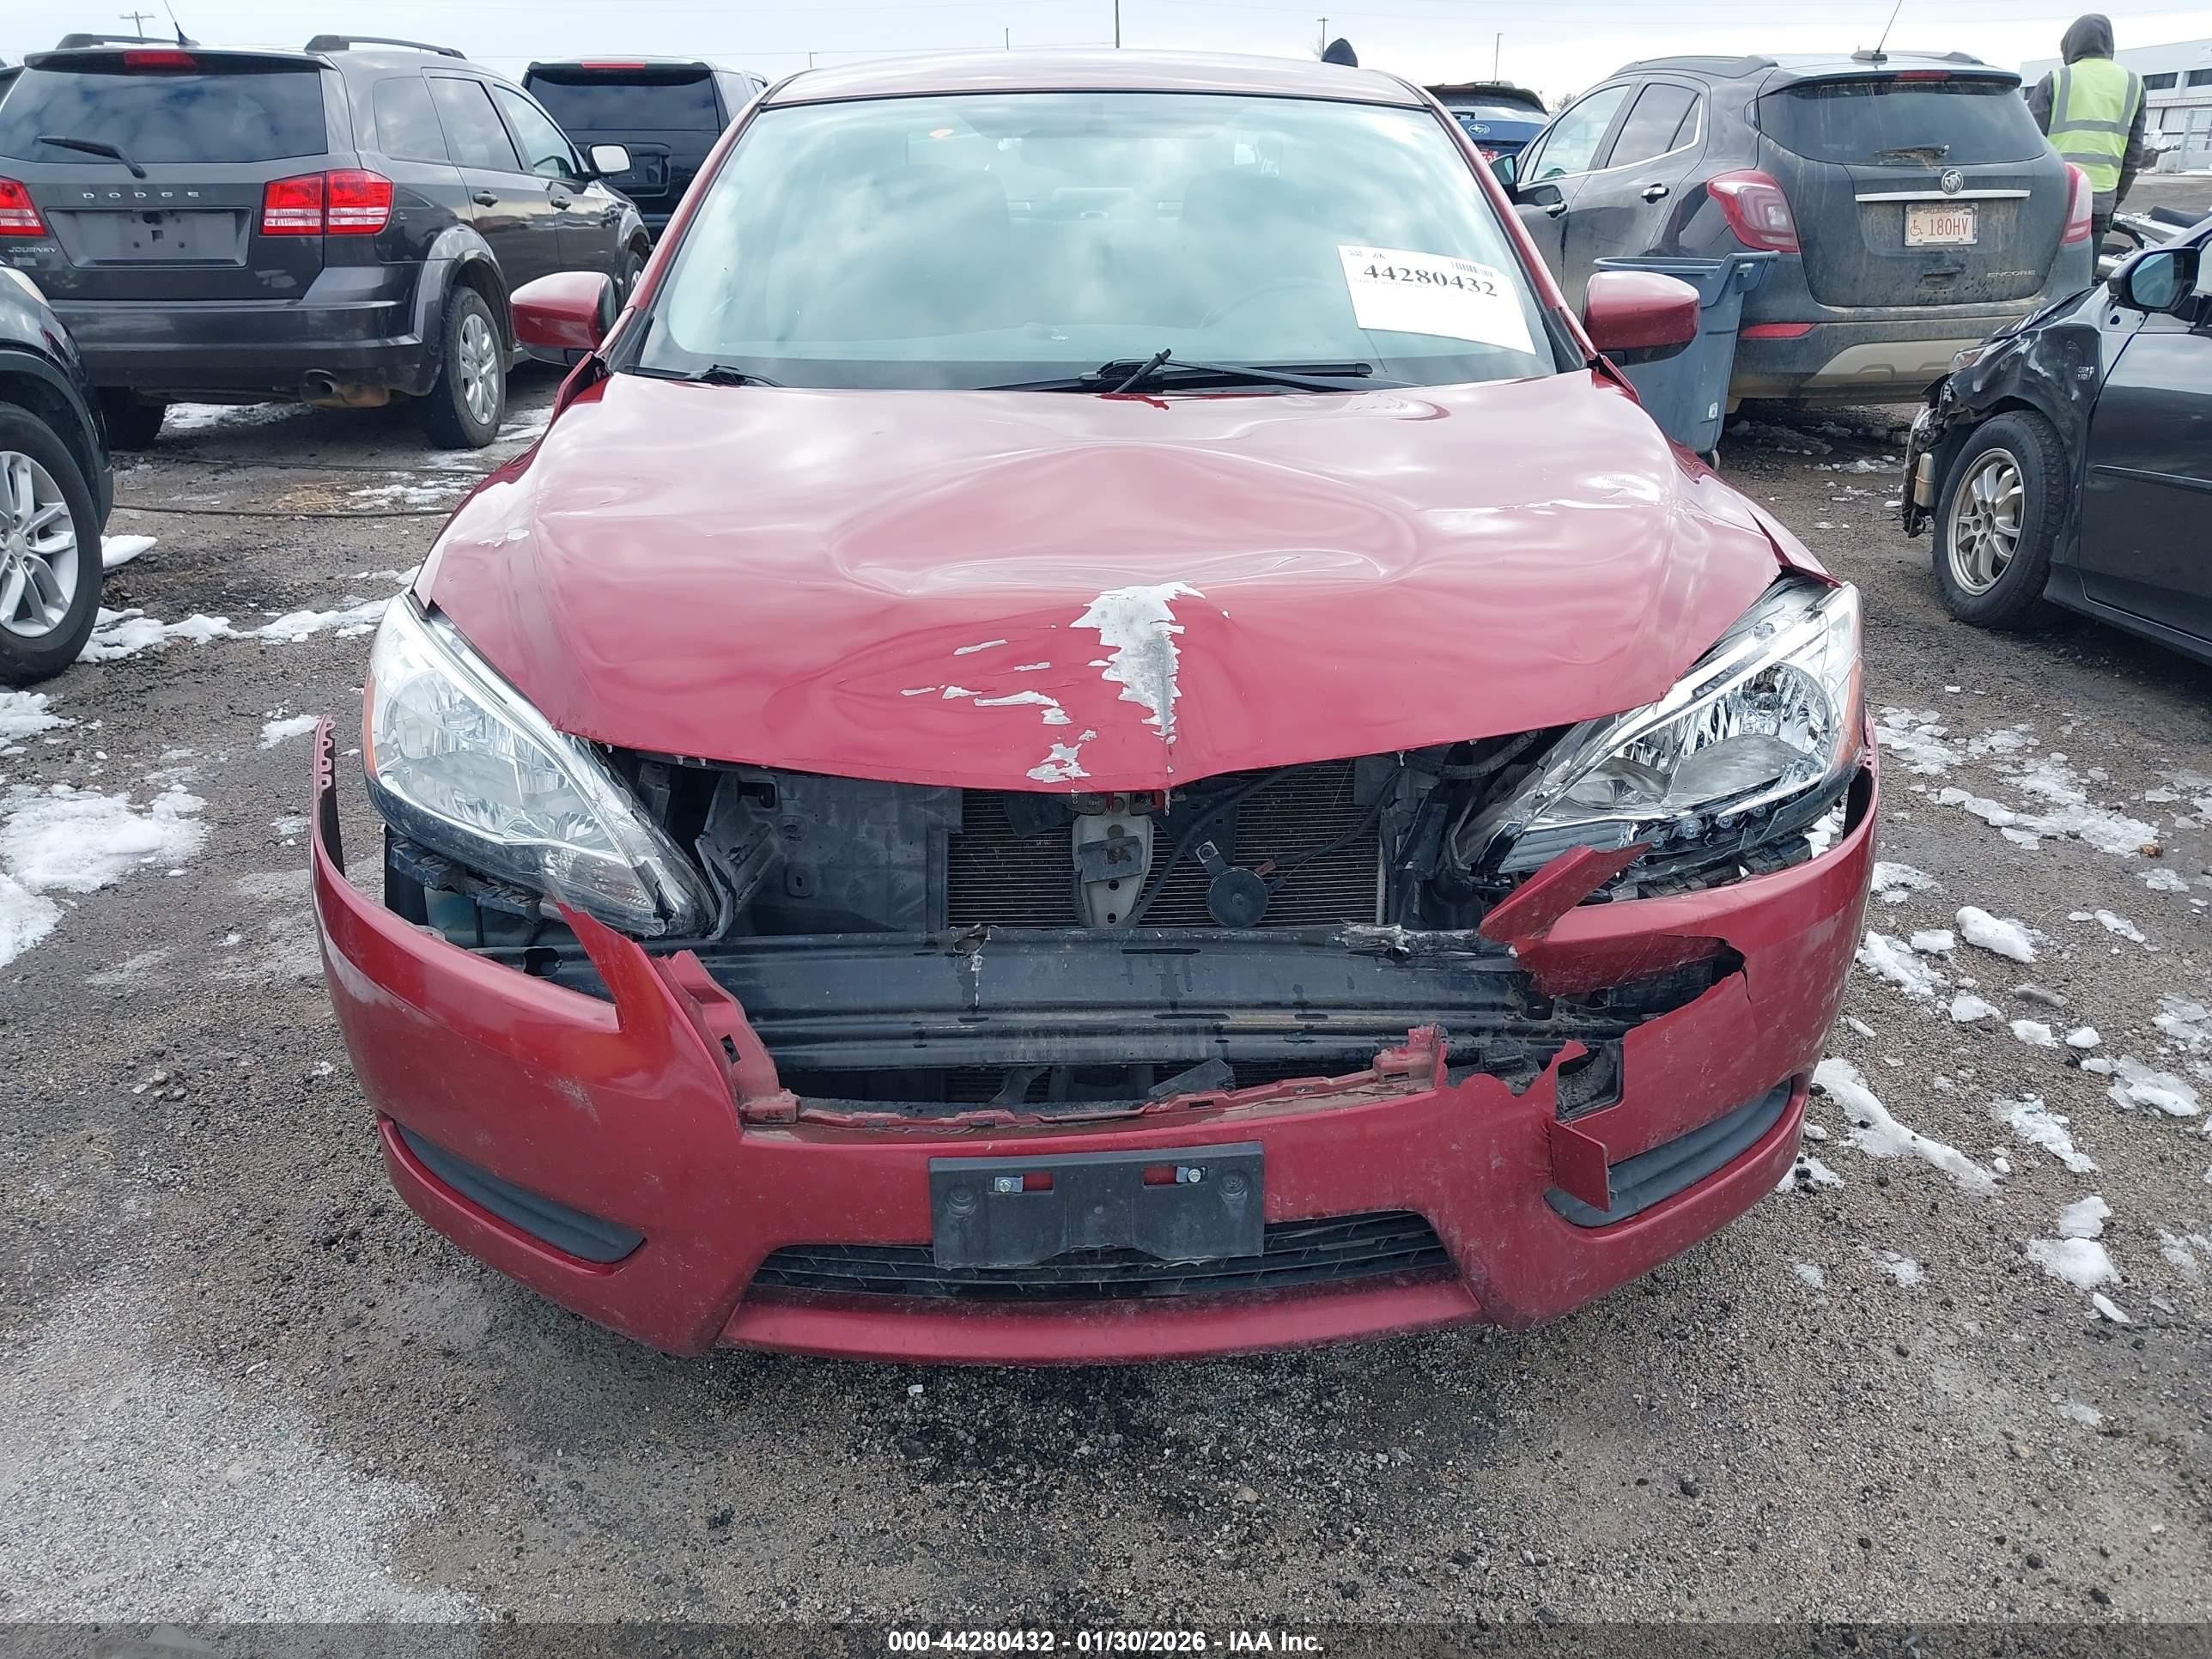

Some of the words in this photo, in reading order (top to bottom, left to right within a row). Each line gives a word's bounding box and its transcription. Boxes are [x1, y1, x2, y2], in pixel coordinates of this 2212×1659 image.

[82, 191, 200, 199] DODGE
[1929, 217, 1969, 236] 180HV
[1363, 264, 1498, 298] 44280432
